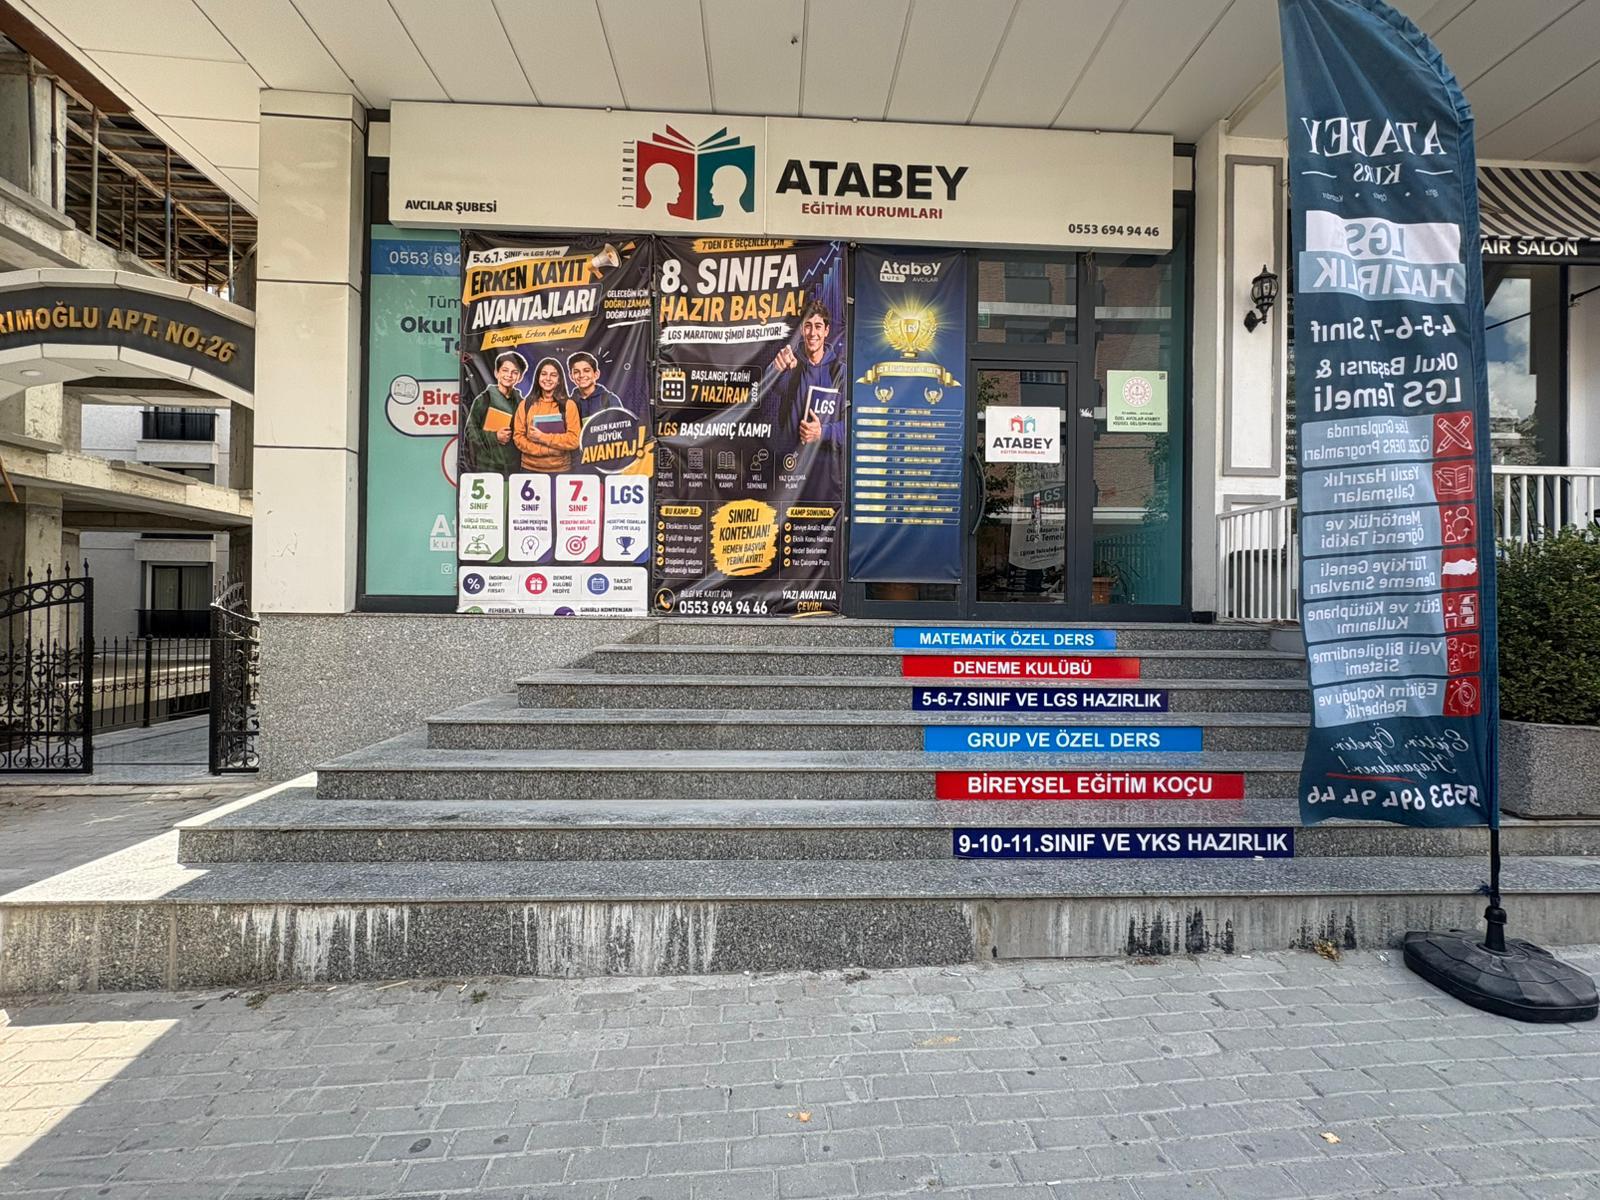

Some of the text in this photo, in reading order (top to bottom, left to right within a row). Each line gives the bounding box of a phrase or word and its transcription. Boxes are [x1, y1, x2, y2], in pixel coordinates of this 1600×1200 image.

[776, 159, 969, 200] ATABEY
[405, 200, 497, 214] AVCILAR ŞUBESİ
[801, 201, 943, 219] EĞİTİM KURUMLARI
[1068, 223, 1160, 237] 0553 694 94 46
[702, 239, 768, 250] 7'DEN 8'E GEÇENLER
[1480, 239, 1579, 256] AIR SALON
[389, 251, 431, 265] 0553
[473, 249, 560, 263] 5.6.7. SINIF İÇİN
[660, 254, 799, 295] 8. SINIFA
[880, 260, 941, 275] Atabey
[471, 258, 588, 296] ERKEN KAYIT
[607, 288, 649, 298] GELECEĞİN İÇİN
[471, 288, 597, 330] AVANTAJLARI
[604, 299, 626, 308] DOĞRU
[659, 290, 805, 325] HAZIR BAŞLA!
[606, 309, 628, 319] DOĞRU
[400, 316, 452, 333] Okul
[107, 307, 158, 337] APT.
[165, 320, 239, 363] NO:26
[491, 324, 582, 344] Başarıya Erken Adım At!
[668, 326, 781, 342] LGS MARATONU ŞİMDİ BAŞLIYOR!
[691, 370, 750, 382] BAŞLANGIÇ TARİHİ
[691, 383, 749, 404] 7 HAZİRAN
[815, 399, 835, 415] LGS
[414, 407, 457, 425] Özel
[590, 420, 632, 433] ERKEN KAYITTA
[658, 422, 771, 439] LGS BAŞLANGIÇ KAMPI
[598, 431, 622, 442] BÜYÜK
[992, 437, 1053, 449] ATABEY
[581, 426, 646, 464] AVANTAJ!
[471, 479, 491, 500] 5.
[520, 480, 541, 501] 6.
[569, 480, 588, 501] 7.
[610, 485, 644, 504] LGS
[728, 508, 759, 523] SINIRLI
[719, 524, 770, 541] KONTENJAN!
[722, 542, 766, 554] HEMEN BAŞVUR
[726, 554, 763, 565] YERİNİ AYIRT!
[680, 588, 695, 598] BİLGİ
[695, 590, 703, 598] VE
[720, 588, 732, 599] İÇİN
[782, 590, 836, 600] YAZI AVANTAJA
[680, 601, 767, 614] 0553 694 94 46
[797, 600, 822, 613] ÇEVİR!
[919, 630, 1095, 646] MATEMATİK ÖZEL DERS
[953, 658, 1092, 675] DENEME KULÜBÜ
[922, 692, 1161, 707] 5-6-7.SINIF VE LGS HAZIRLIK
[967, 729, 1161, 748] GRUP VE ÖZEL DERS
[967, 773, 1213, 798] BİREYSEL EĞİTİM KOÇU
[958, 833, 1289, 853] 9-10-11.SINIF VE YKS HAZIRLIK
